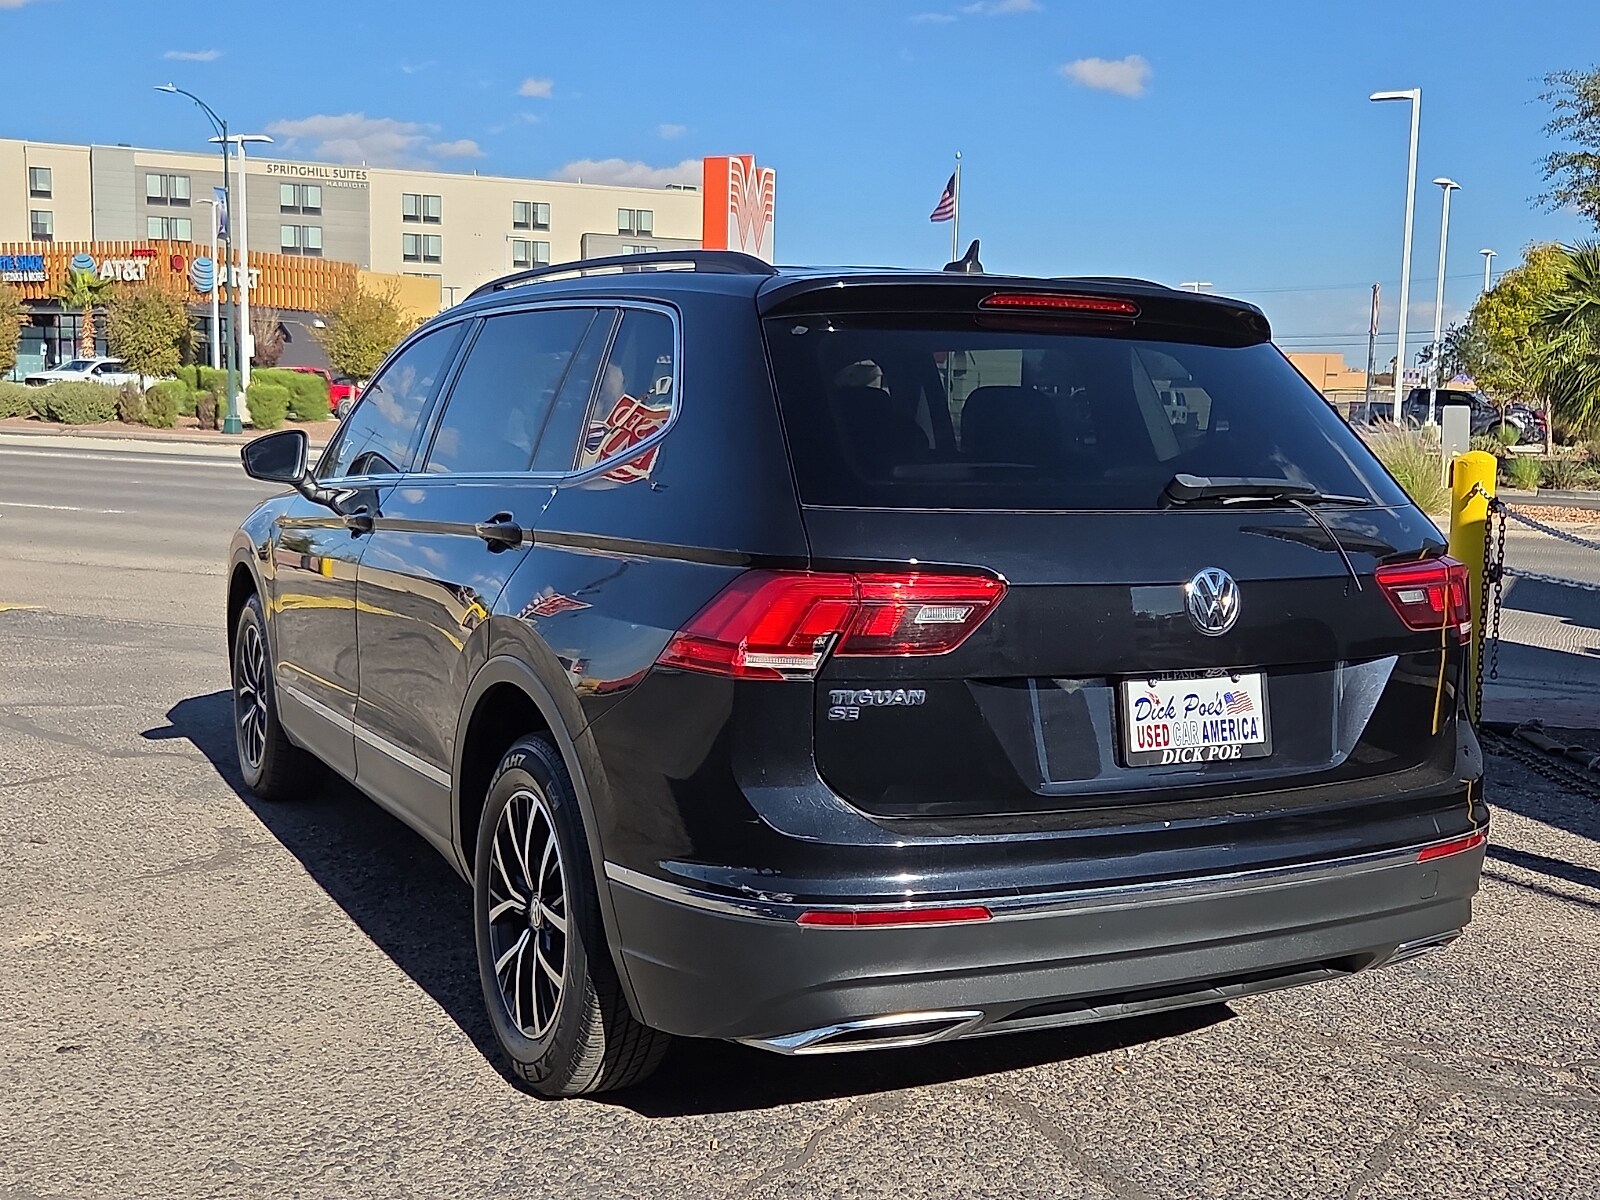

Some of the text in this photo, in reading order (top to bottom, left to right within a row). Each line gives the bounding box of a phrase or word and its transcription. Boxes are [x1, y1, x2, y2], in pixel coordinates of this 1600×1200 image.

[266, 163, 368, 180] SPRINGHILL SUITES
[100, 259, 150, 282] AT&T
[828, 689, 926, 706] TIGUAN
[1134, 691, 1226, 722] Dick Poe's
[827, 706, 860, 720] SE
[1136, 717, 1258, 749] USED CAR AMERICA
[1160, 744, 1242, 765] DICK POE
